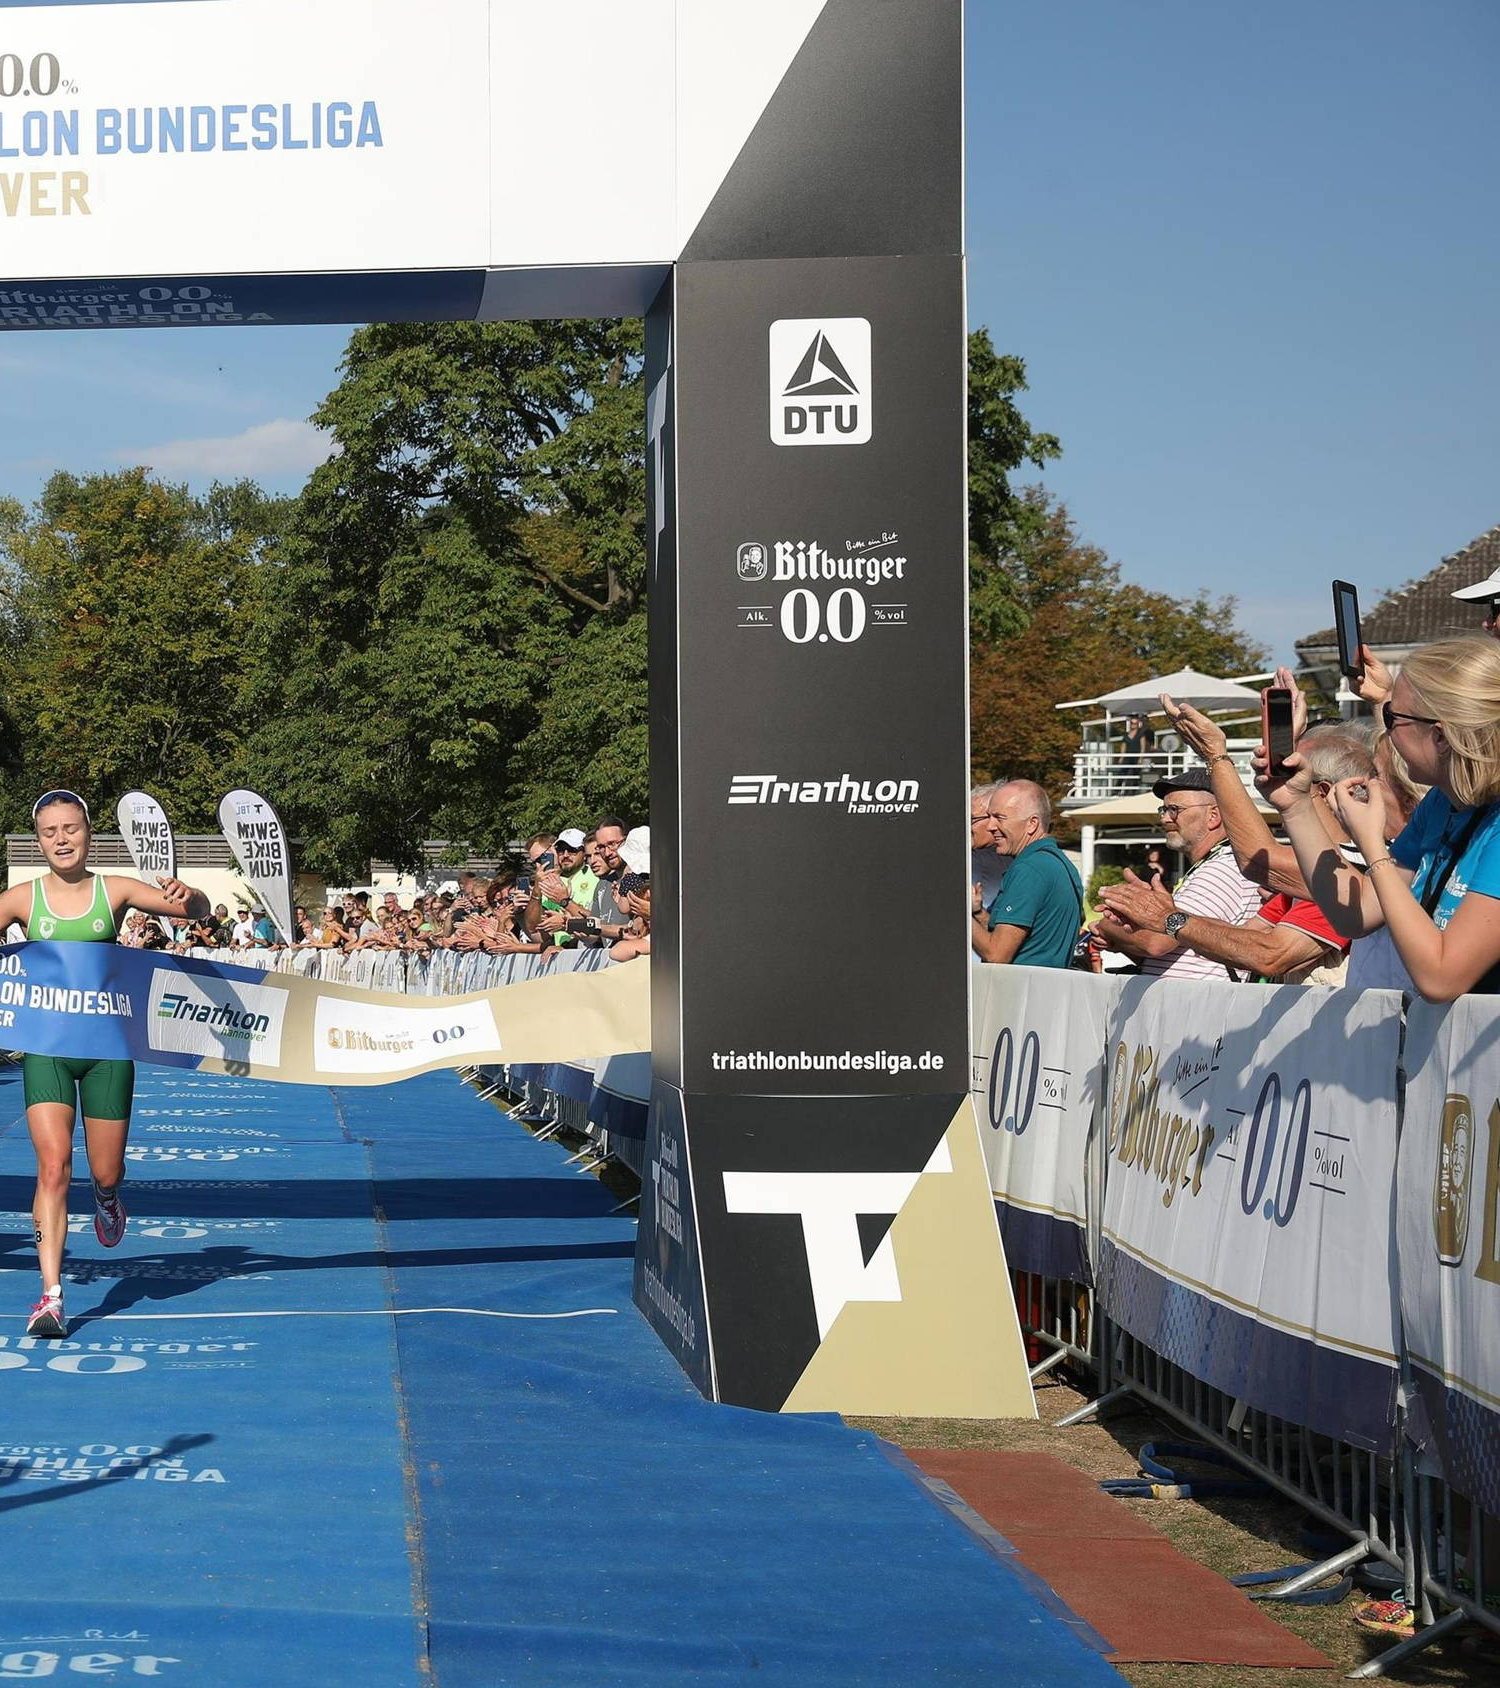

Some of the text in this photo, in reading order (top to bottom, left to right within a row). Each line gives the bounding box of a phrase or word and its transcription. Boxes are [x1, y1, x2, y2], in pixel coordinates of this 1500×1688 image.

[97, 101, 384, 154] BUNDESLIGA
[783, 405, 858, 434] DTU
[772, 541, 907, 586] Bitburger
[746, 611, 769, 621] Alk.
[780, 588, 866, 643] 0.0
[728, 774, 919, 804] Triathlon
[847, 802, 919, 813] hannover
[29, 984, 133, 1018] BUNDESLIGA
[158, 993, 269, 1033] Triathlon
[221, 1027, 266, 1042] hannover
[345, 1025, 465, 1054] Bitburger 0.0
[712, 1050, 944, 1075] triathlonbundesliga.de
[989, 1027, 1040, 1136] 0.0
[1241, 1072, 1311, 1227] 0.0
[35, 1230, 42, 1243] 8
